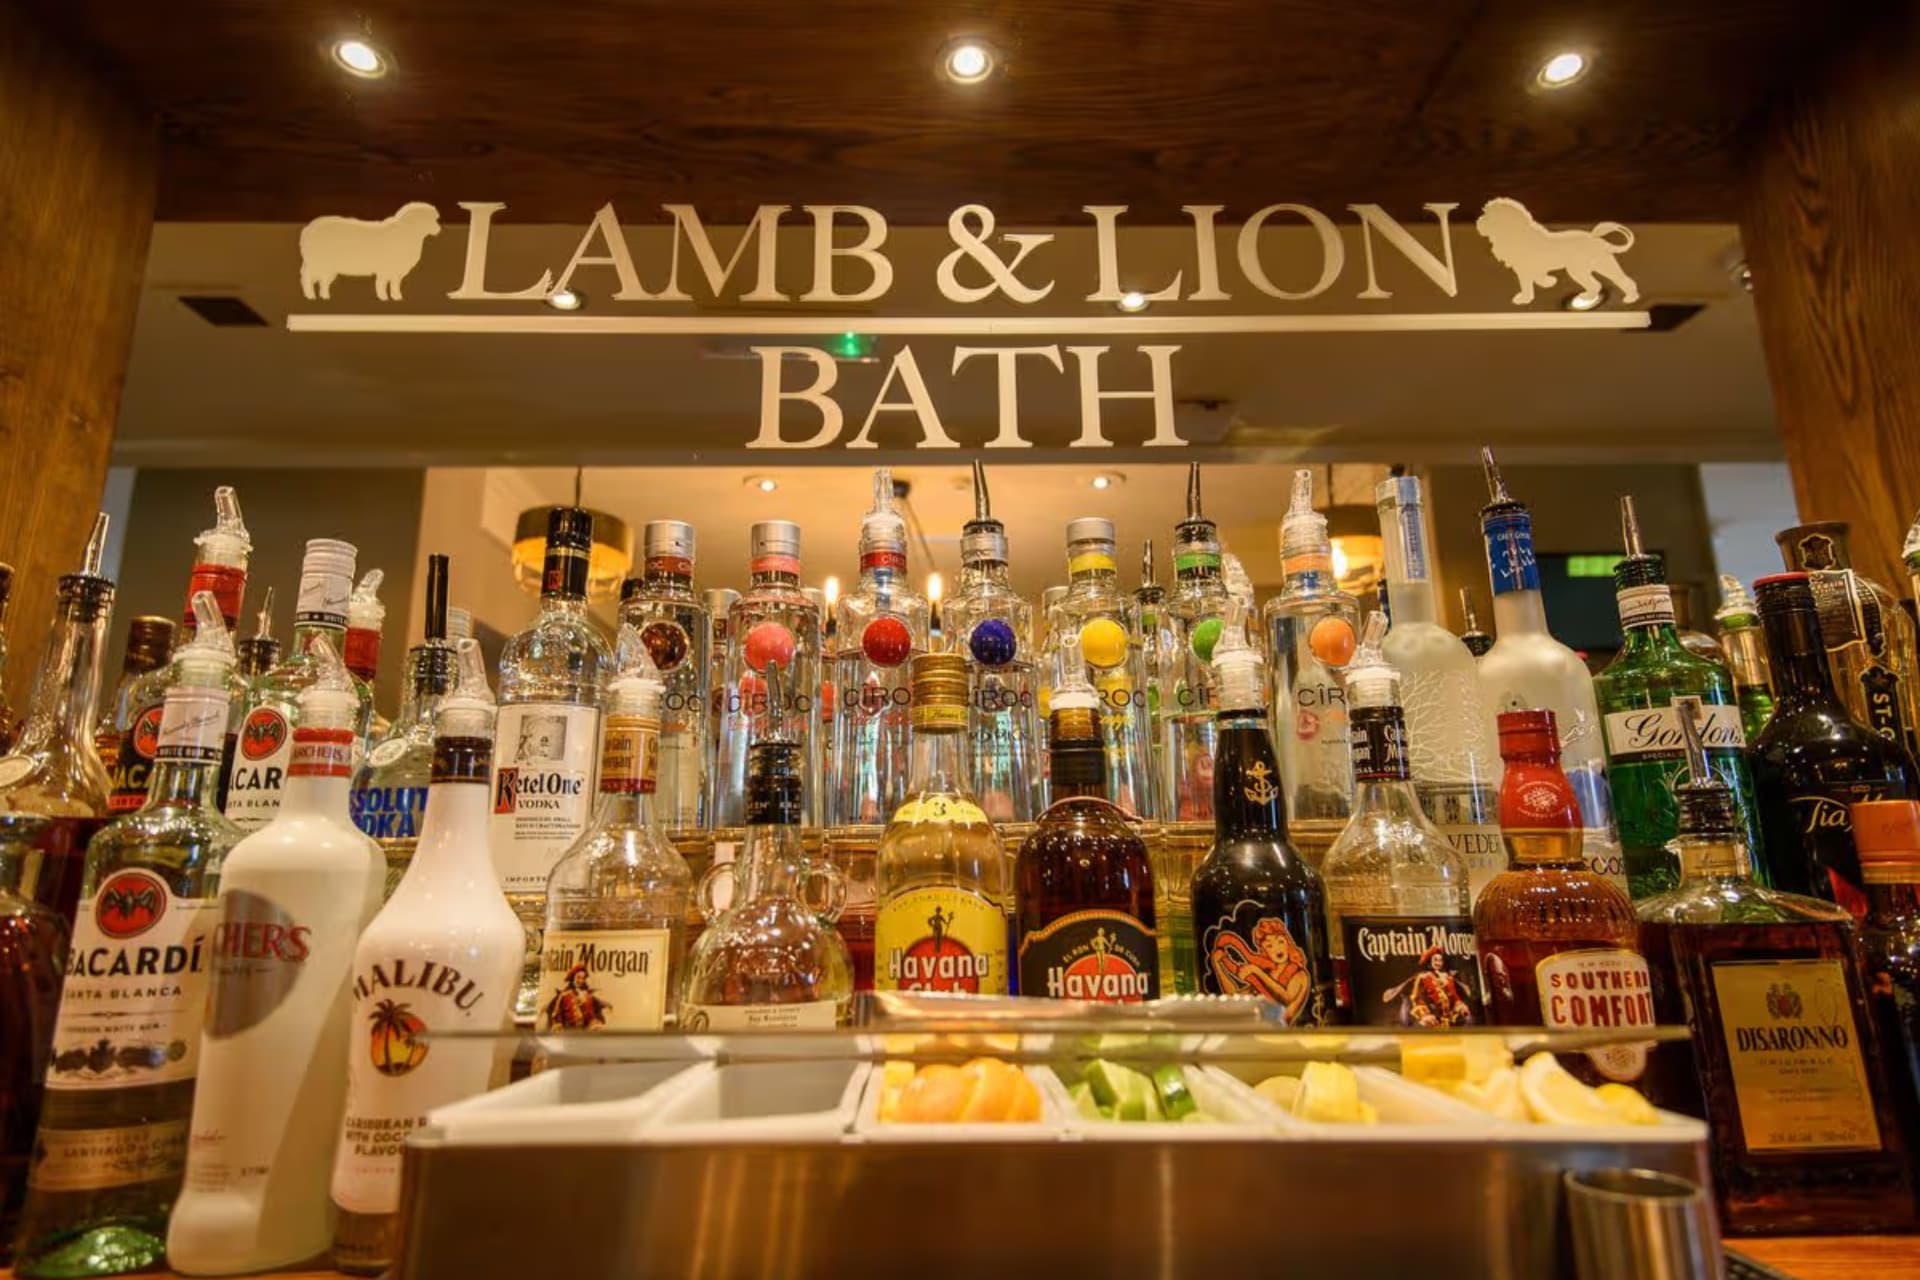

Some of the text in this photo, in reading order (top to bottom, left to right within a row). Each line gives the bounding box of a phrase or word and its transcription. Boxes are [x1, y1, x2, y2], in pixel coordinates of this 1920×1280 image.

[446, 201, 1460, 304] LAMB & LION
[744, 345, 1190, 450] BATH
[844, 683, 912, 706] CÎRO
[496, 770, 582, 811] Ketel One
[518, 799, 561, 810] VODKA
[1357, 925, 1426, 962] Captain
[575, 942, 650, 978] Morgan
[888, 947, 989, 979] Havana
[109, 985, 182, 999] BLANCA
[1047, 966, 1149, 998] Havana
[1735, 1025, 1849, 1053] DISARONNO
